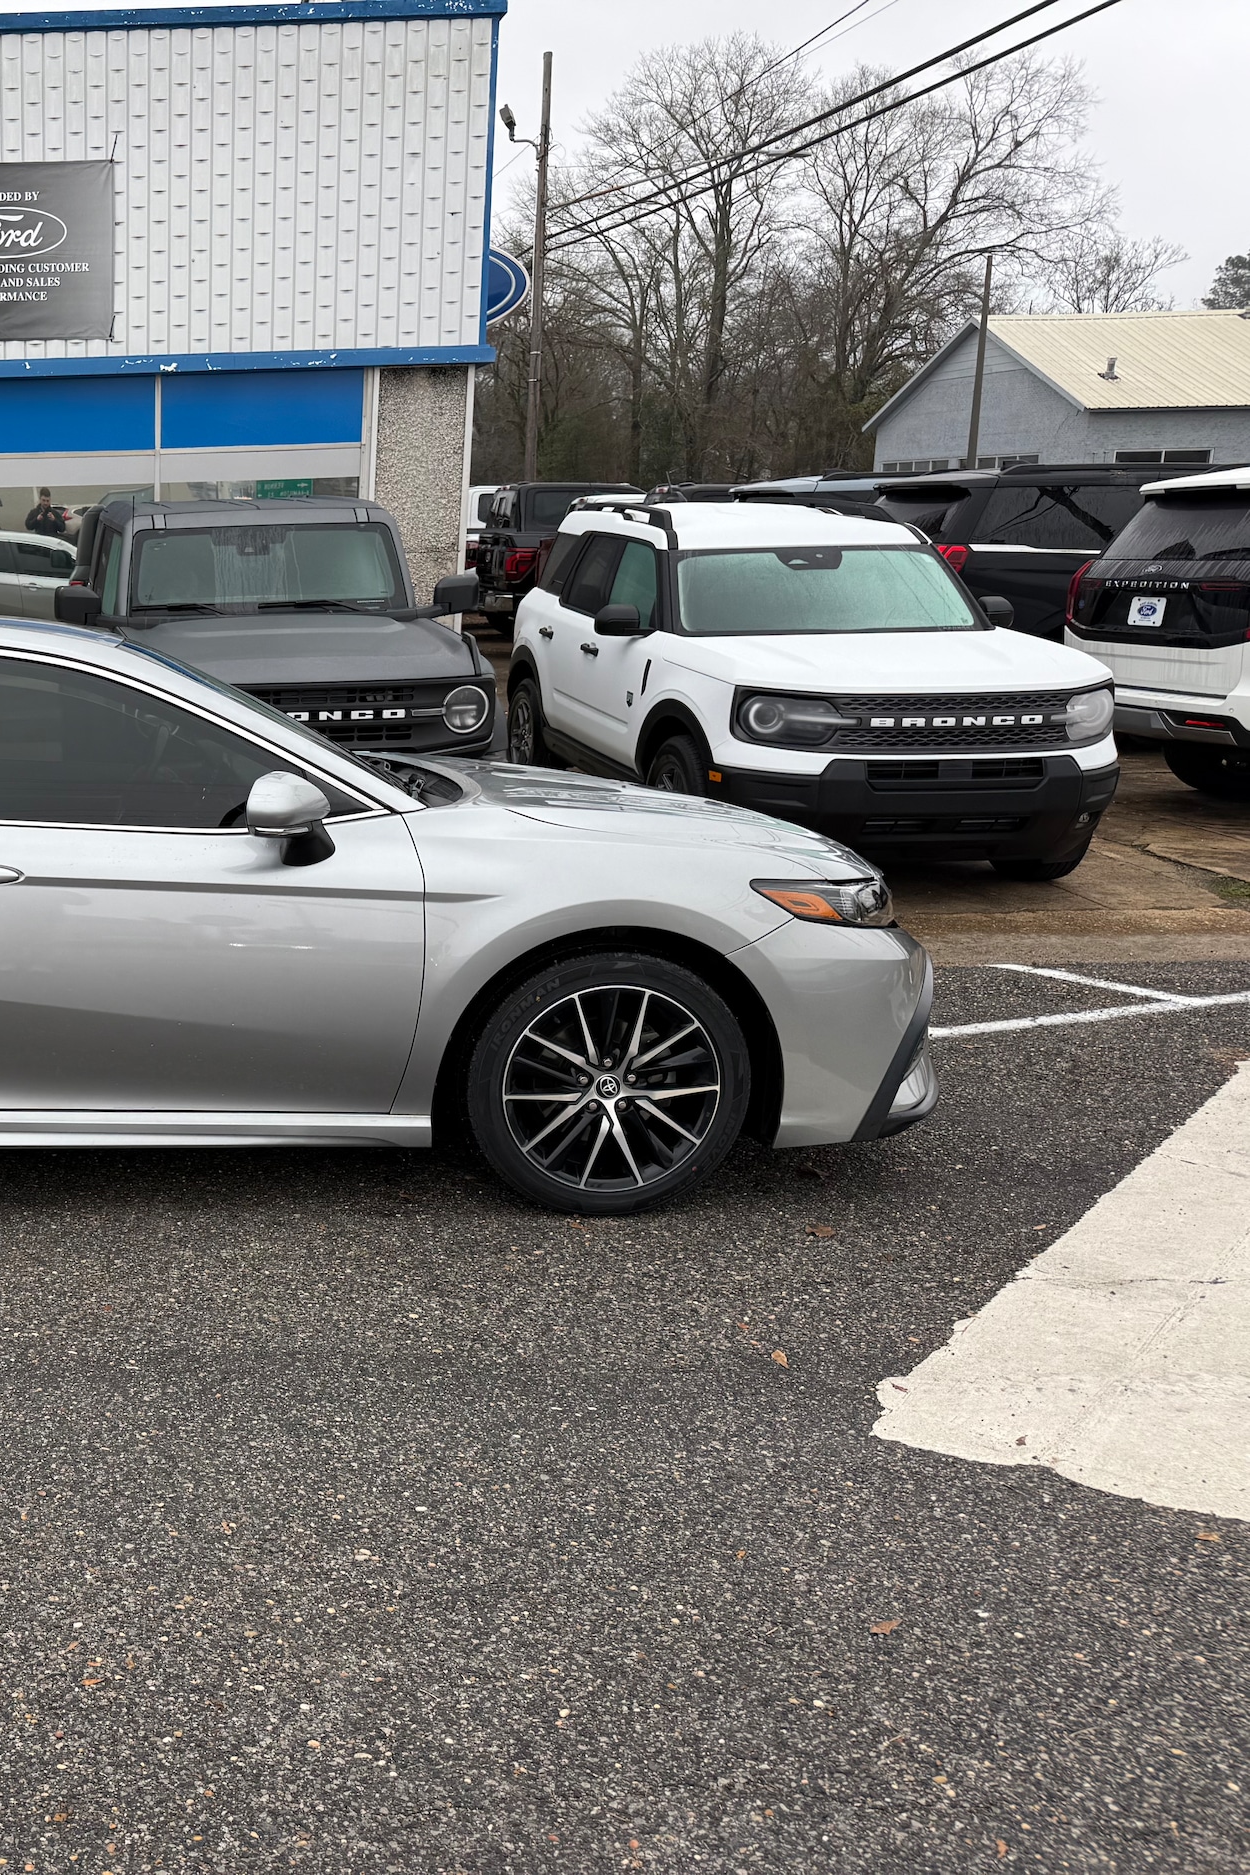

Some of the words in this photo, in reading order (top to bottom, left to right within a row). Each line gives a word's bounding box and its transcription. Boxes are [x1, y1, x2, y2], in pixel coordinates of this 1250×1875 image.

[25, 191, 39, 201] BY
[28, 262, 90, 273] CUSTOMER
[0, 278, 24, 288] AND
[26, 277, 61, 287] SALES
[1105, 580, 1190, 590] EXPEDITION
[286, 709, 406, 722] ONCO
[870, 715, 1043, 728] BRONCO
